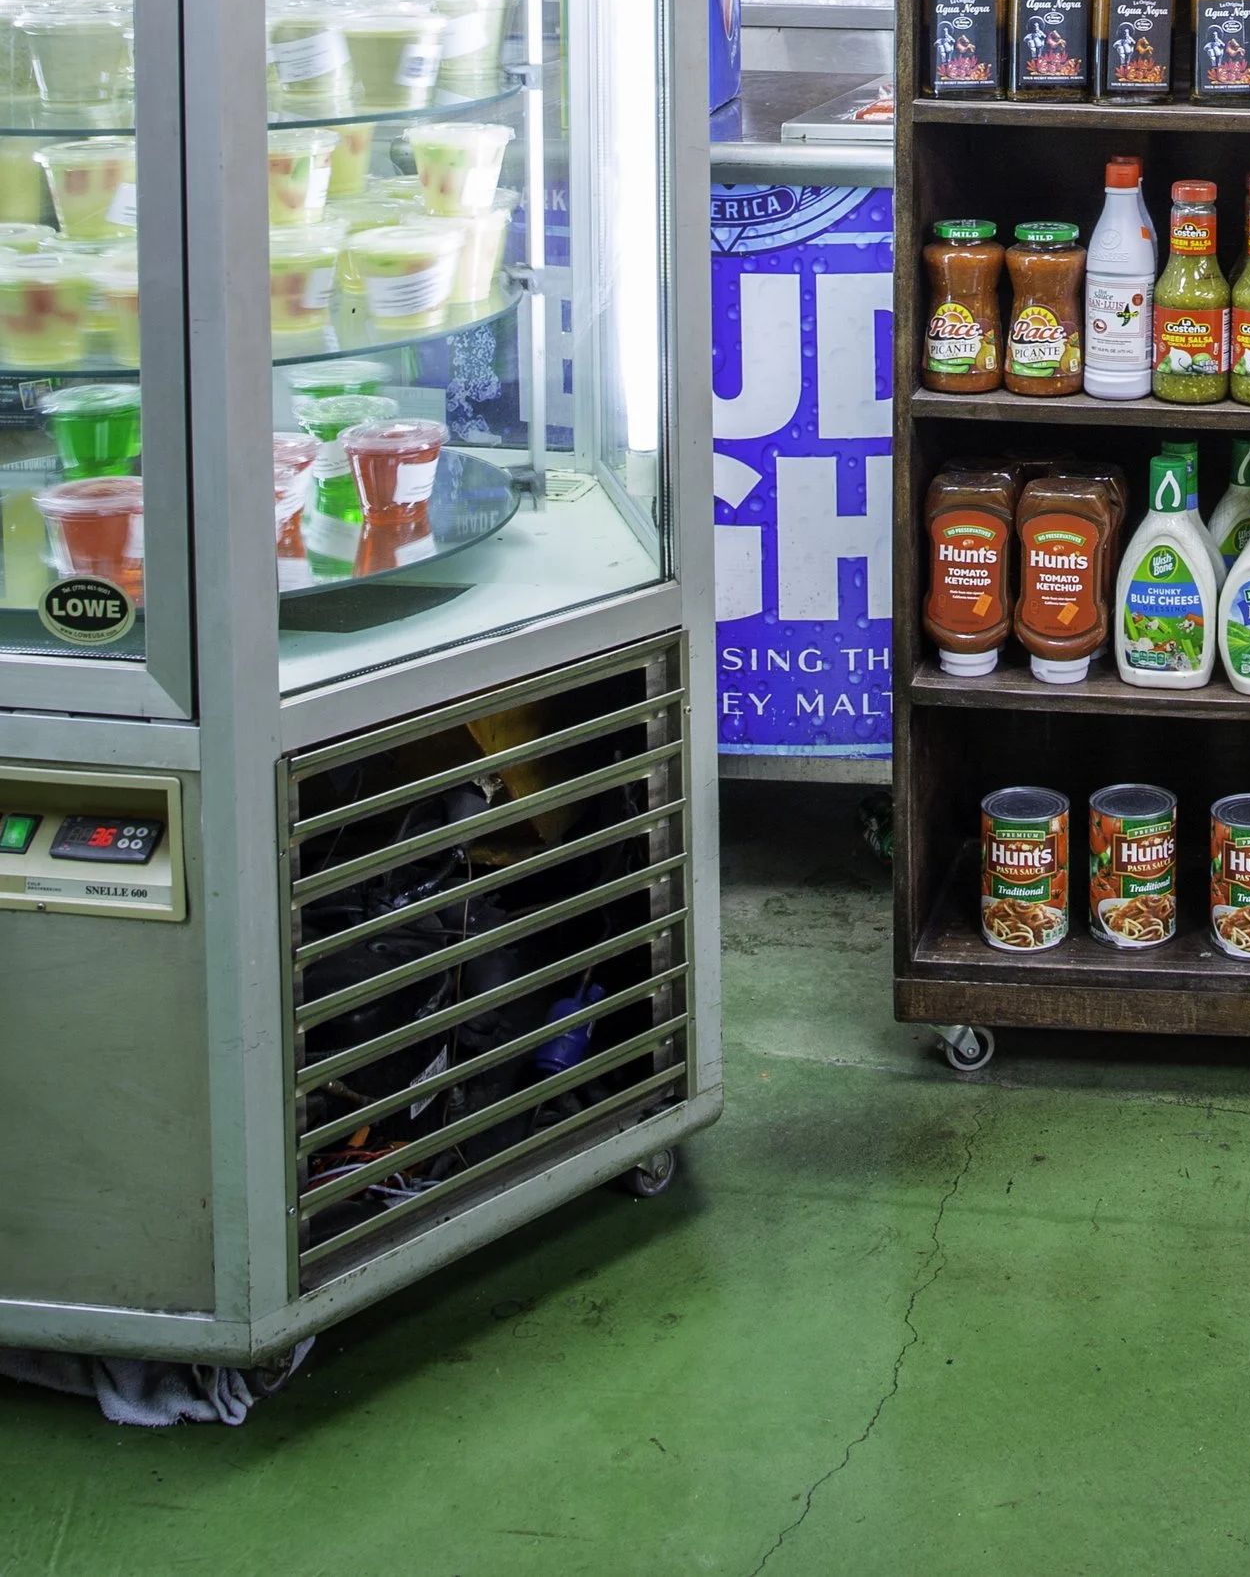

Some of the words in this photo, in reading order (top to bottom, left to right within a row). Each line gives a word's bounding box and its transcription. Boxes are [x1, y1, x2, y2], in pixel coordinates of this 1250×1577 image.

[936, 4, 961, 15] Agua
[962, 5, 990, 14] Negra
[1026, 0, 1052, 9] Agua
[1053, 0, 1081, 9] Negra
[929, 318, 980, 338] Pace
[1012, 321, 1063, 341] Pace
[1166, 323, 1207, 334] Costeña
[1162, 334, 1186, 342] GREEN
[1187, 335, 1213, 343] SALSA
[930, 343, 976, 355] PICANTE
[1014, 347, 1060, 359] PICANTE
[939, 544, 997, 563] Hunt's
[1030, 550, 1088, 569] Hunt's
[948, 568, 988, 577] TOMATO
[1039, 574, 1079, 583] TOMATO
[945, 576, 991, 587] KETCHUP
[1036, 582, 1082, 593] KETCHUP
[1131, 593, 1157, 604] BLUE
[1159, 595, 1200, 605] CHEESE
[52, 598, 121, 618] LOWE
[88, 827, 117, 847] 36
[996, 866, 1018, 875] PASTA
[1019, 867, 1045, 875] SAUCE
[1127, 863, 1151, 872] PASTA
[85, 886, 128, 897] SNELLE
[131, 889, 147, 898] 600
[997, 884, 1044, 896] Traditional
